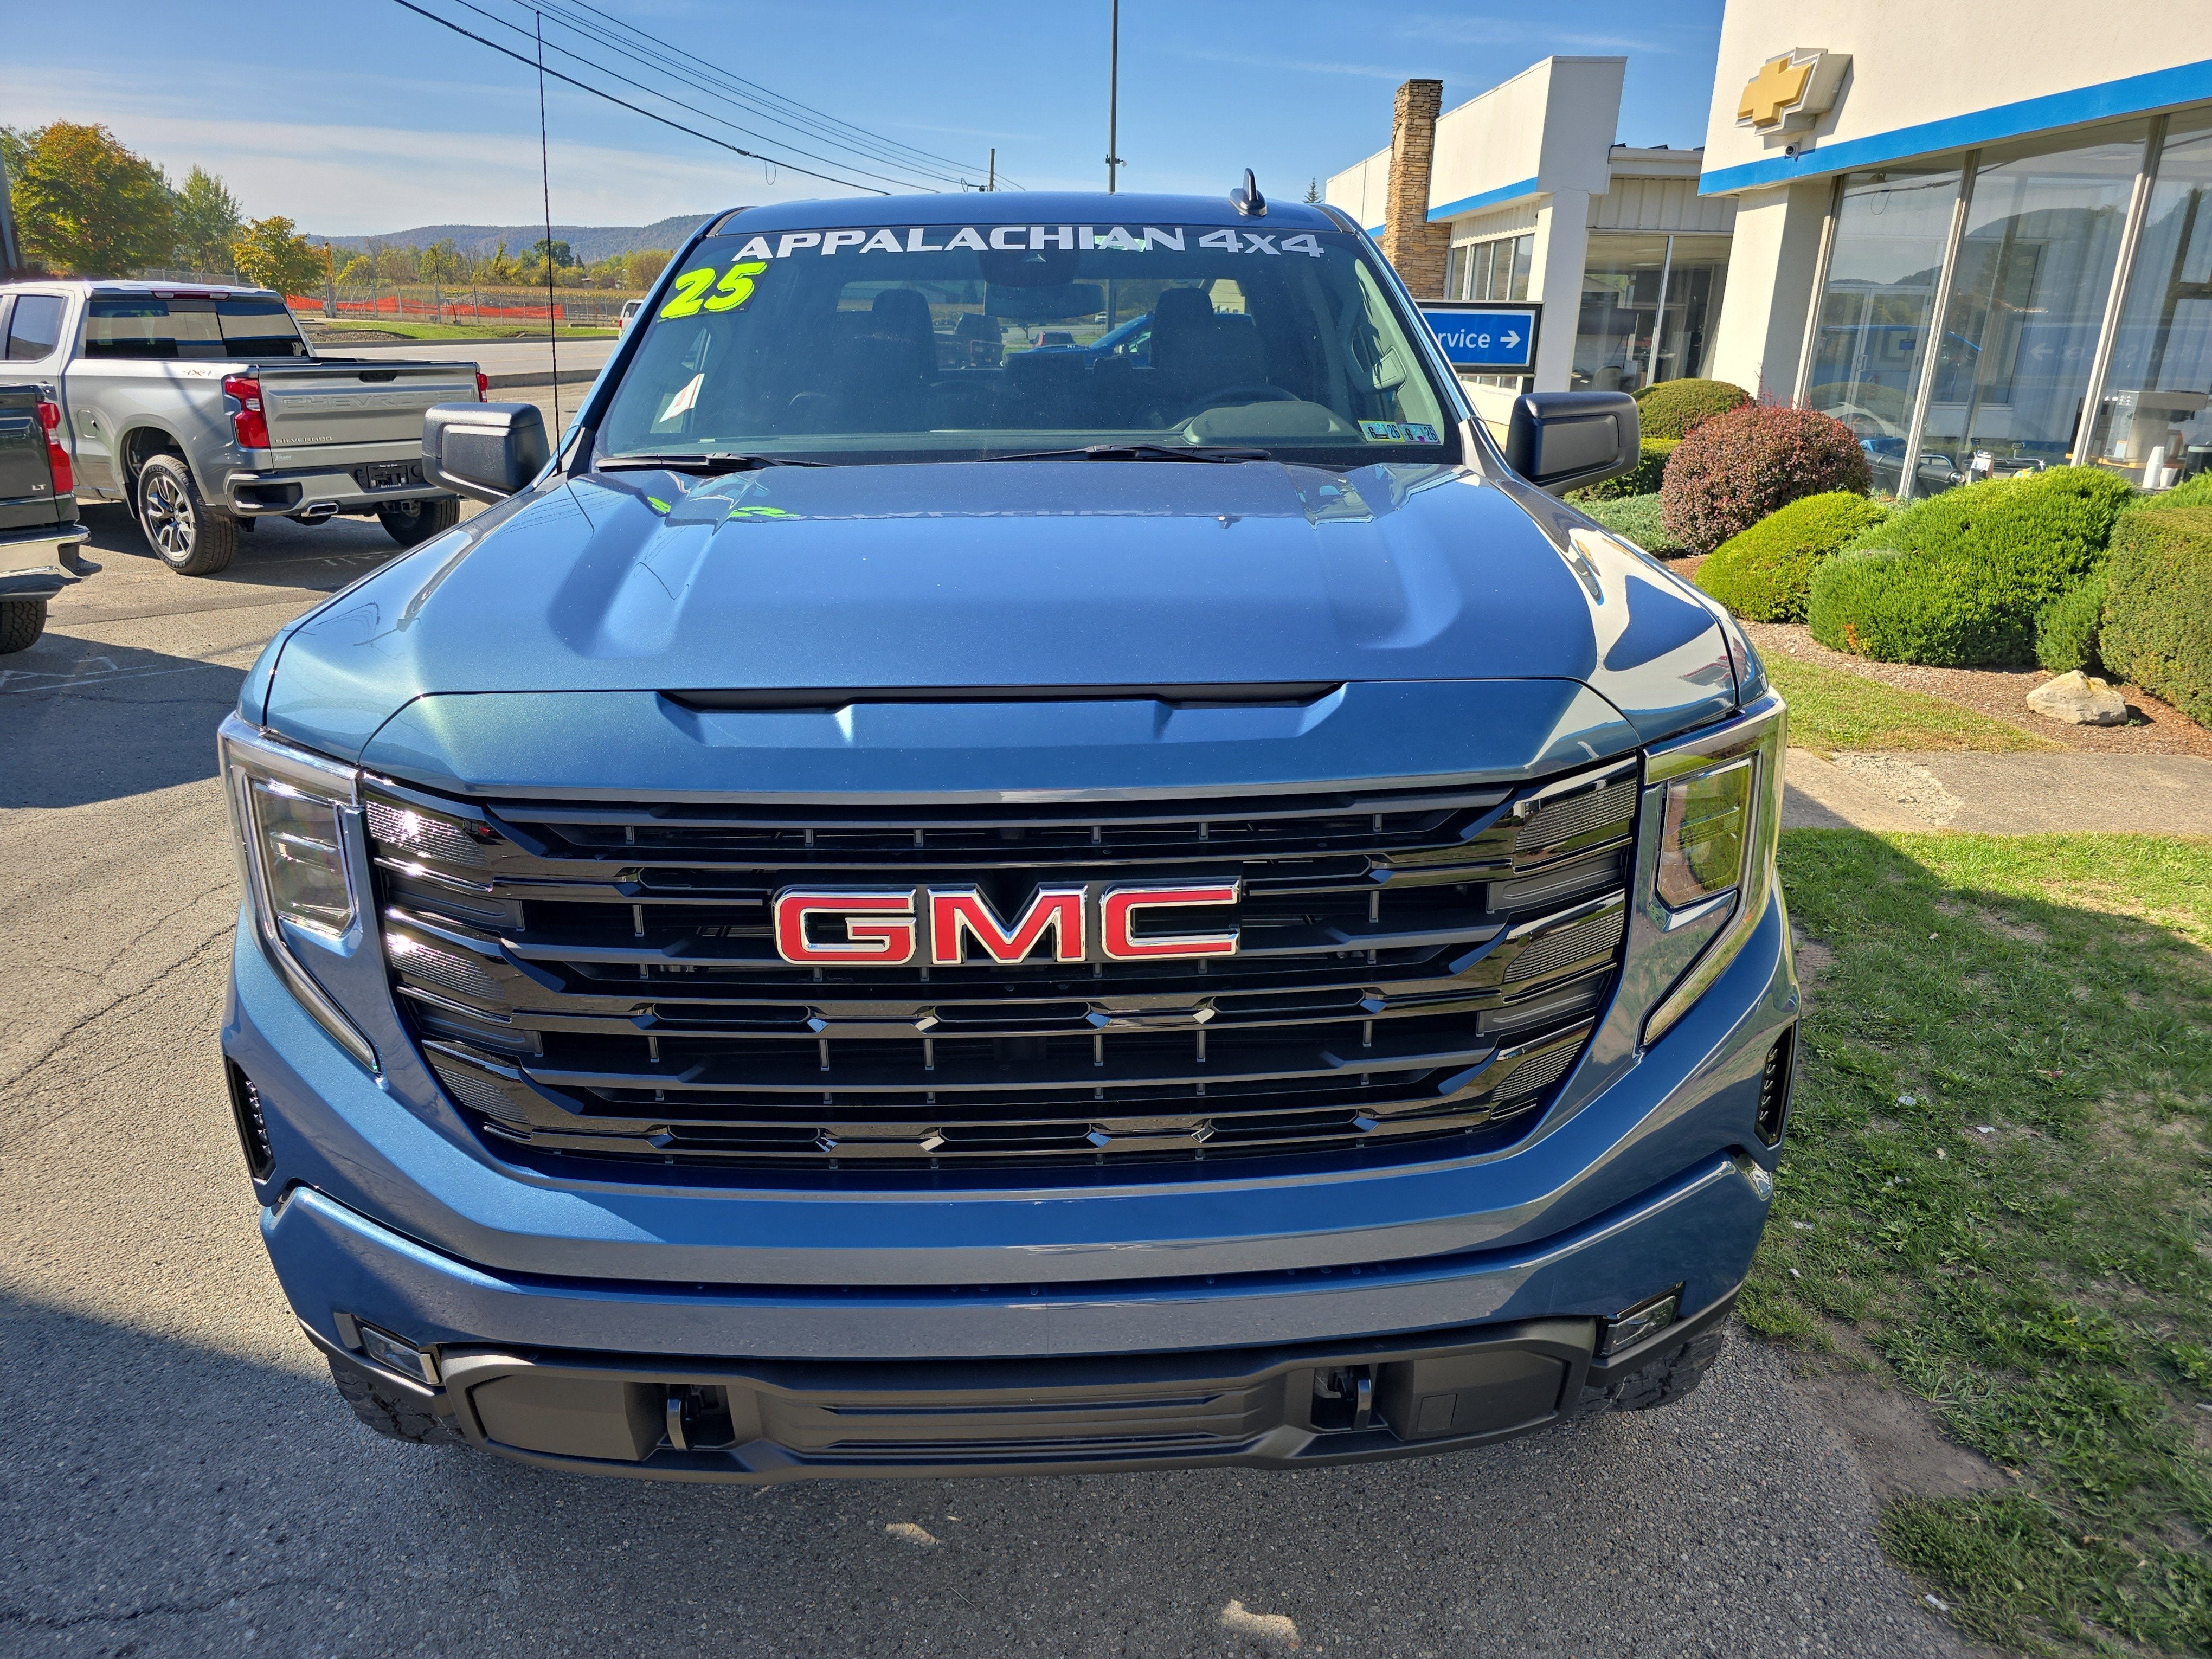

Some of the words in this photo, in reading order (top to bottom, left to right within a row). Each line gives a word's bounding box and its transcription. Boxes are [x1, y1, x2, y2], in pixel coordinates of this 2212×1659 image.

[731, 227, 1185, 261] APPALACHIAN
[660, 262, 767, 319] 25
[1438, 329, 1490, 348] rvice
[281, 390, 470, 410] CHEVROLET
[1387, 425, 1401, 438] 26
[1424, 427, 1437, 440] 26
[774, 878, 1240, 965] GMC
